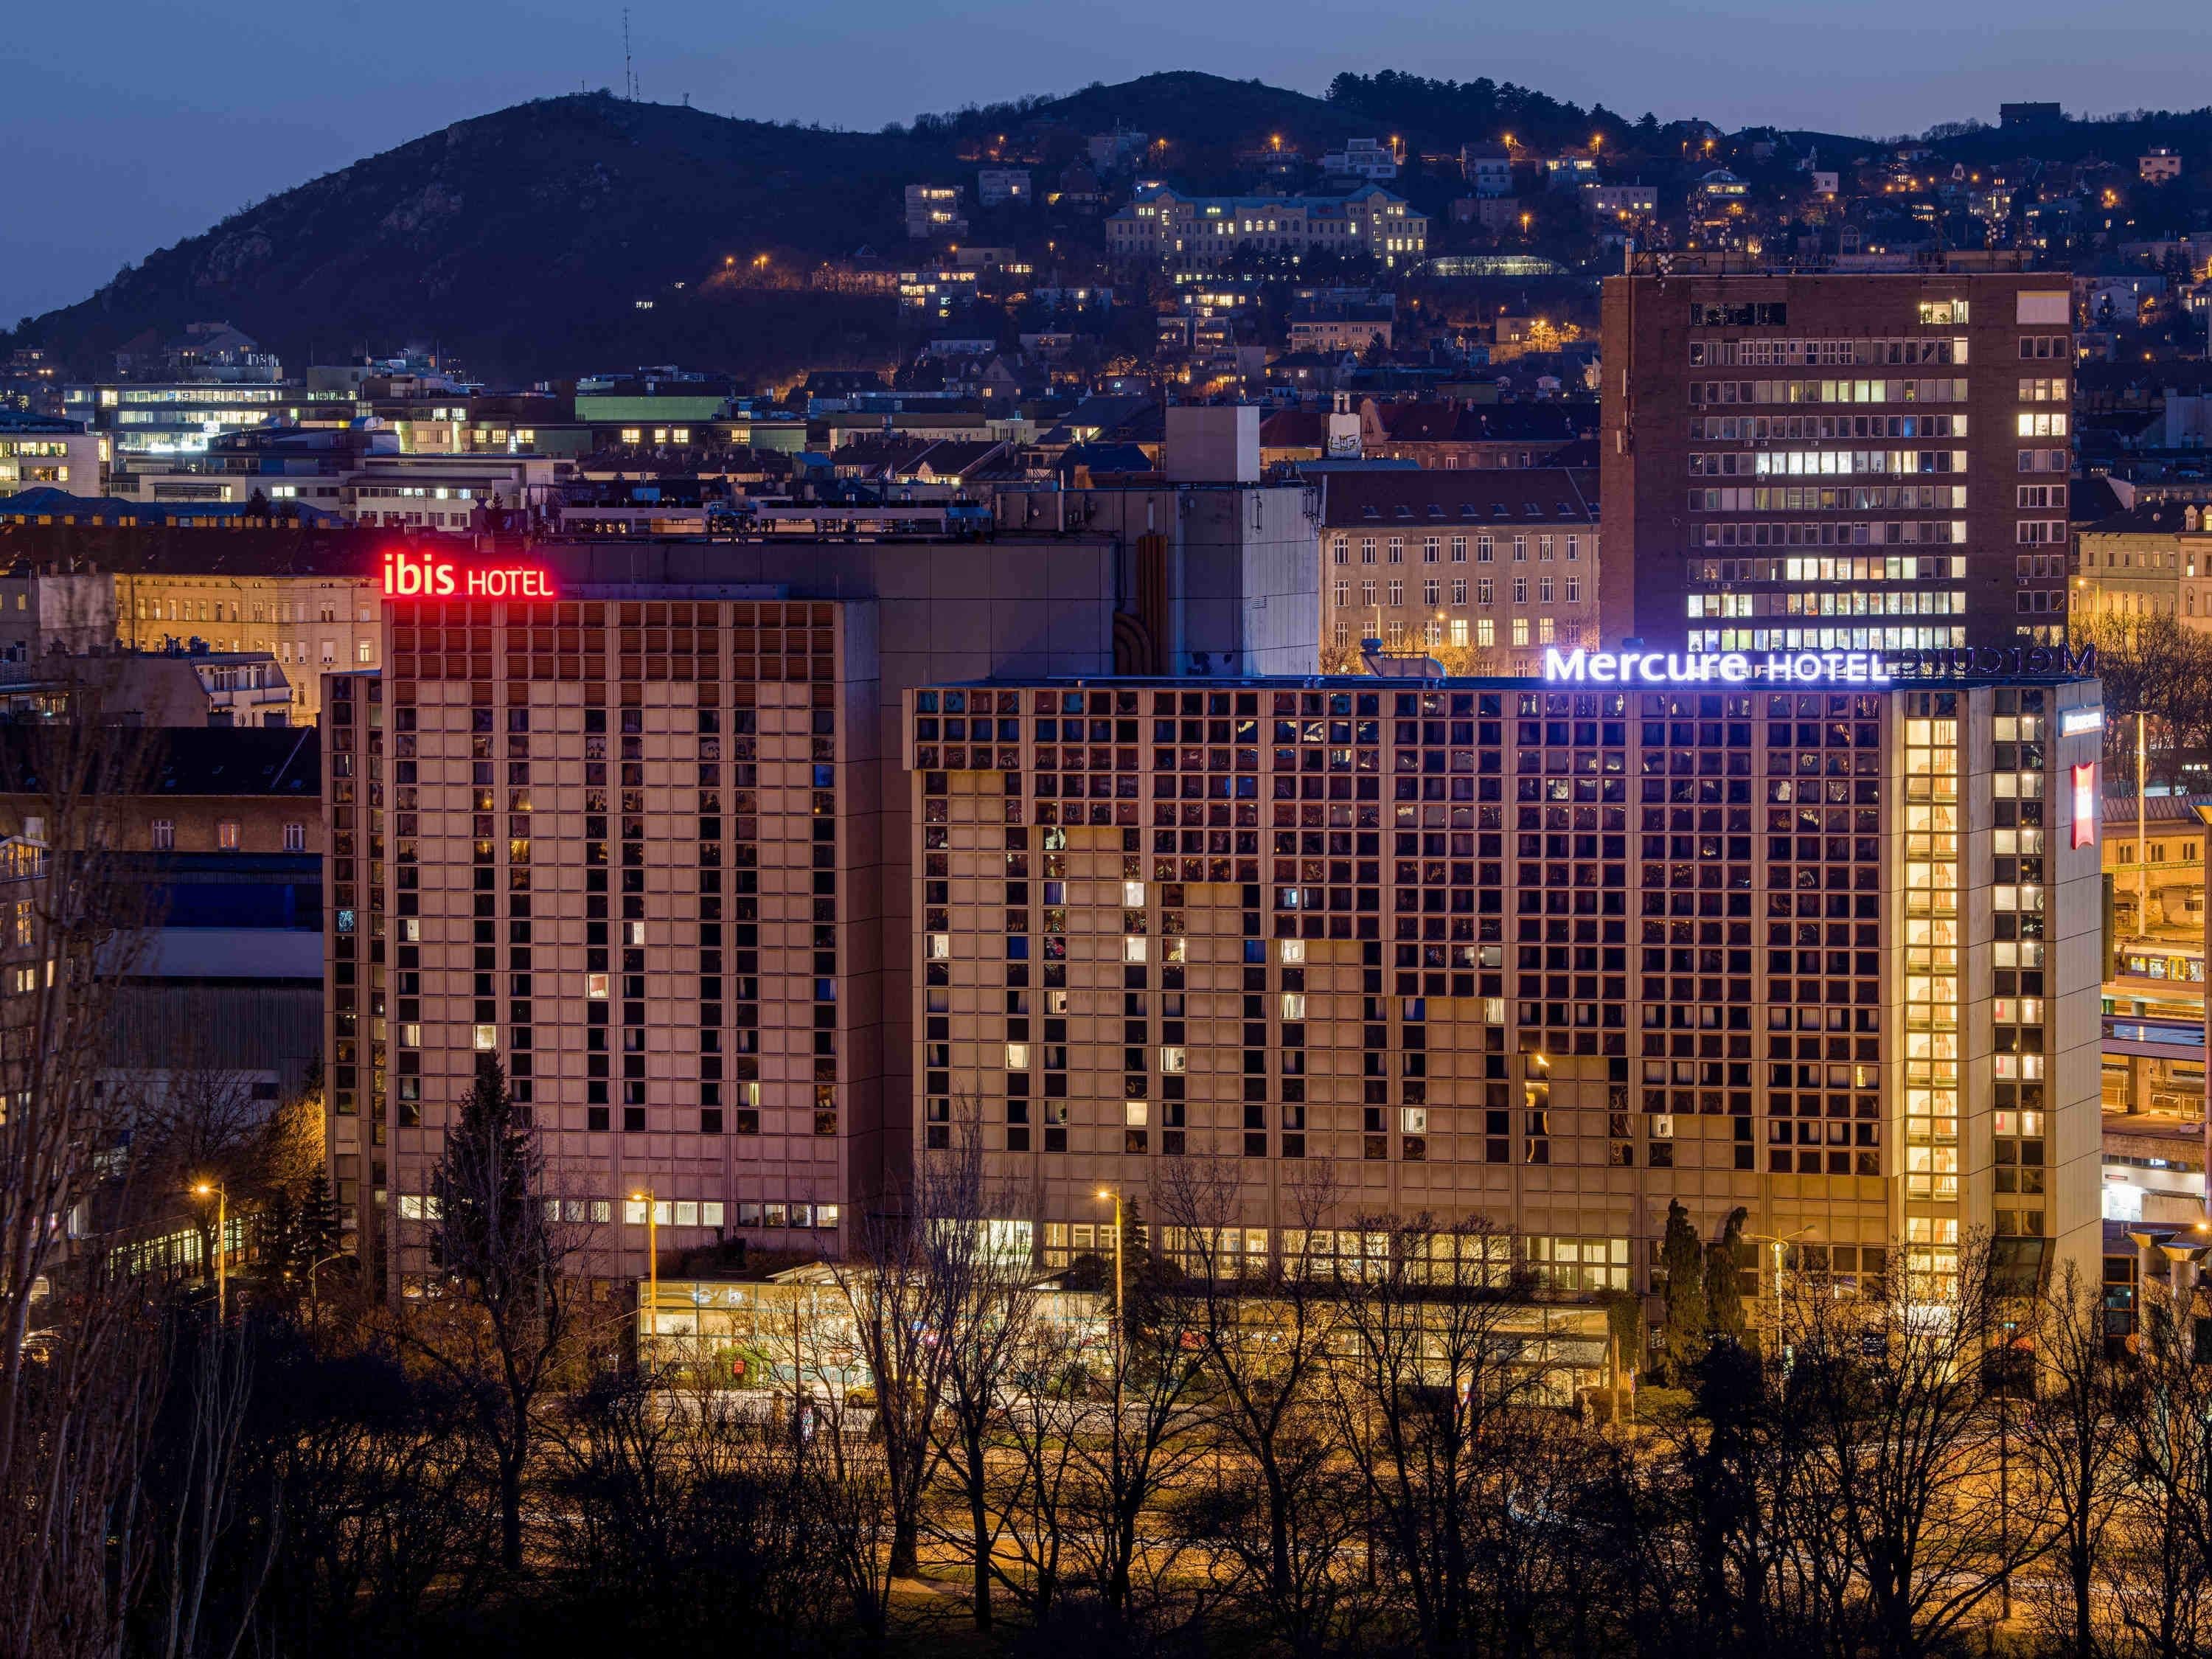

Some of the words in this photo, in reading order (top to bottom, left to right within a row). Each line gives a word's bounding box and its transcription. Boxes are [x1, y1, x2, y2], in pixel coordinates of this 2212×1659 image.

[384, 553, 456, 596] ibis
[467, 570, 554, 597] HOTEL
[1545, 647, 1747, 681] Mercure
[1768, 653, 1891, 681] HOTEL
